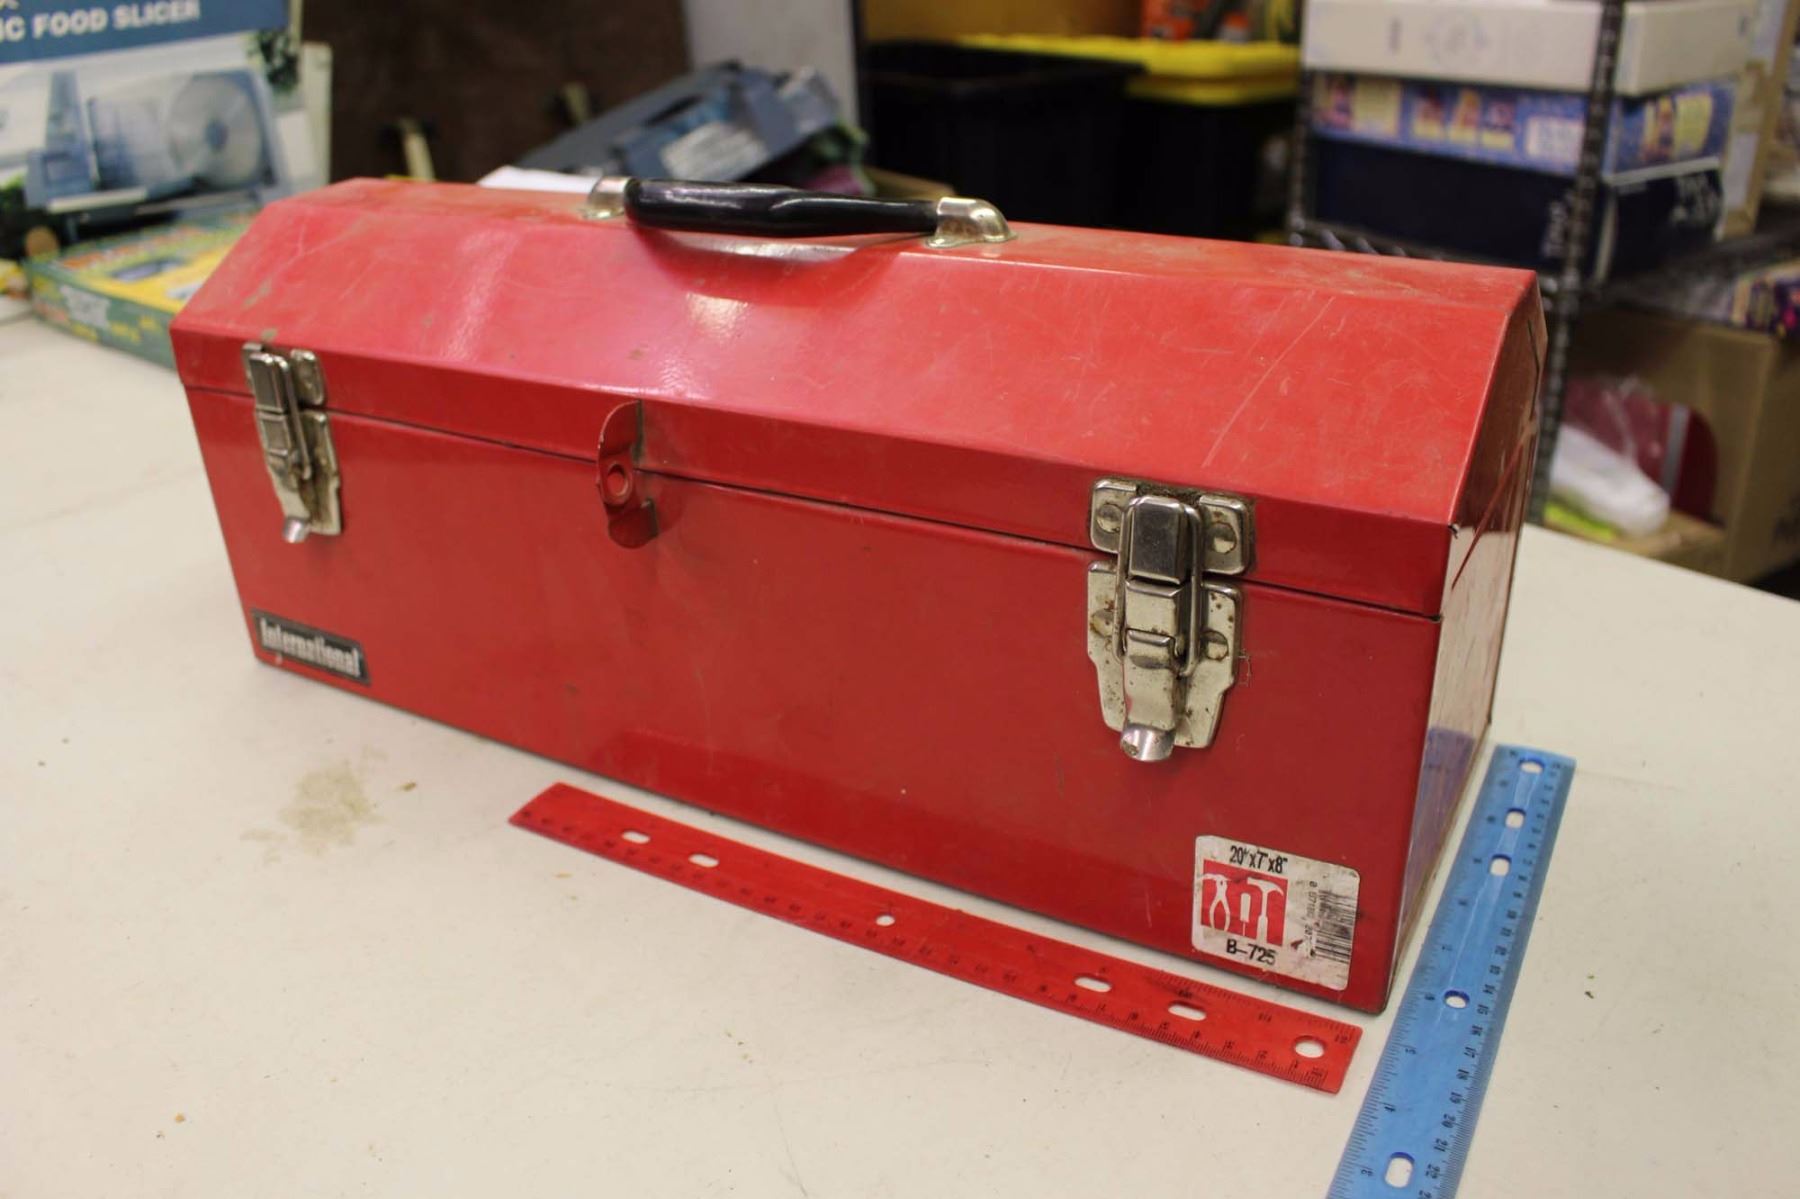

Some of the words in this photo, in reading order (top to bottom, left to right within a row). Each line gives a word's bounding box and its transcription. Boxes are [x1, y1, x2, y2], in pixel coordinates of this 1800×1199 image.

[32, 7, 109, 39] FOOD
[113, 0, 200, 30] SLICER
[1442, 1114, 1456, 1128] 20
[1434, 1138, 1448, 1152] 21
[1425, 1164, 1441, 1179] 22
